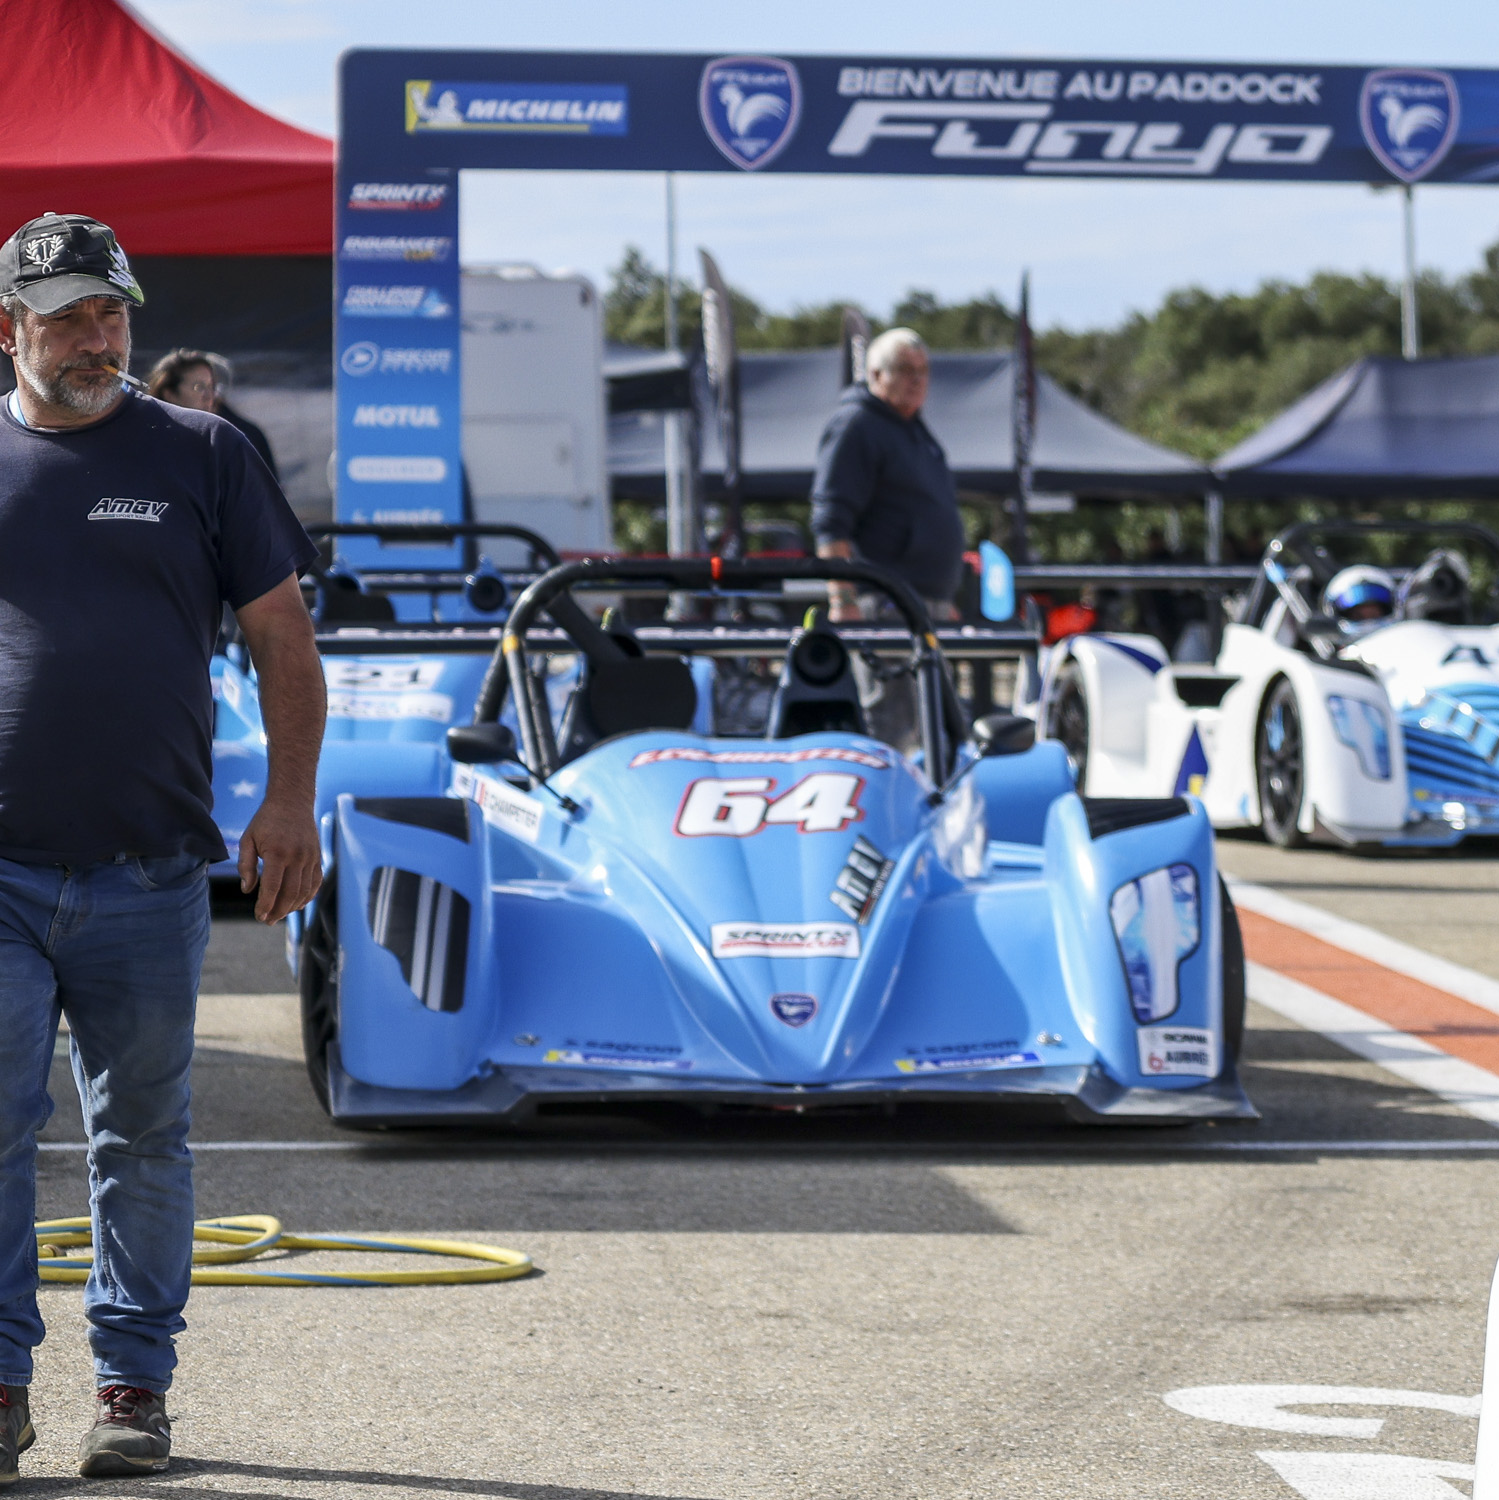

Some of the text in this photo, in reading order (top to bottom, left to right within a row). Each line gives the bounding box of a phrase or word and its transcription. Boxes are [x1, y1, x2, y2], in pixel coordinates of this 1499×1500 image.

[837, 67, 1322, 104] BIENVENUE AU PADDOCK
[466, 99, 624, 122] MICHELIN
[353, 404, 440, 428] MOTUL
[672, 770, 866, 838] 64
